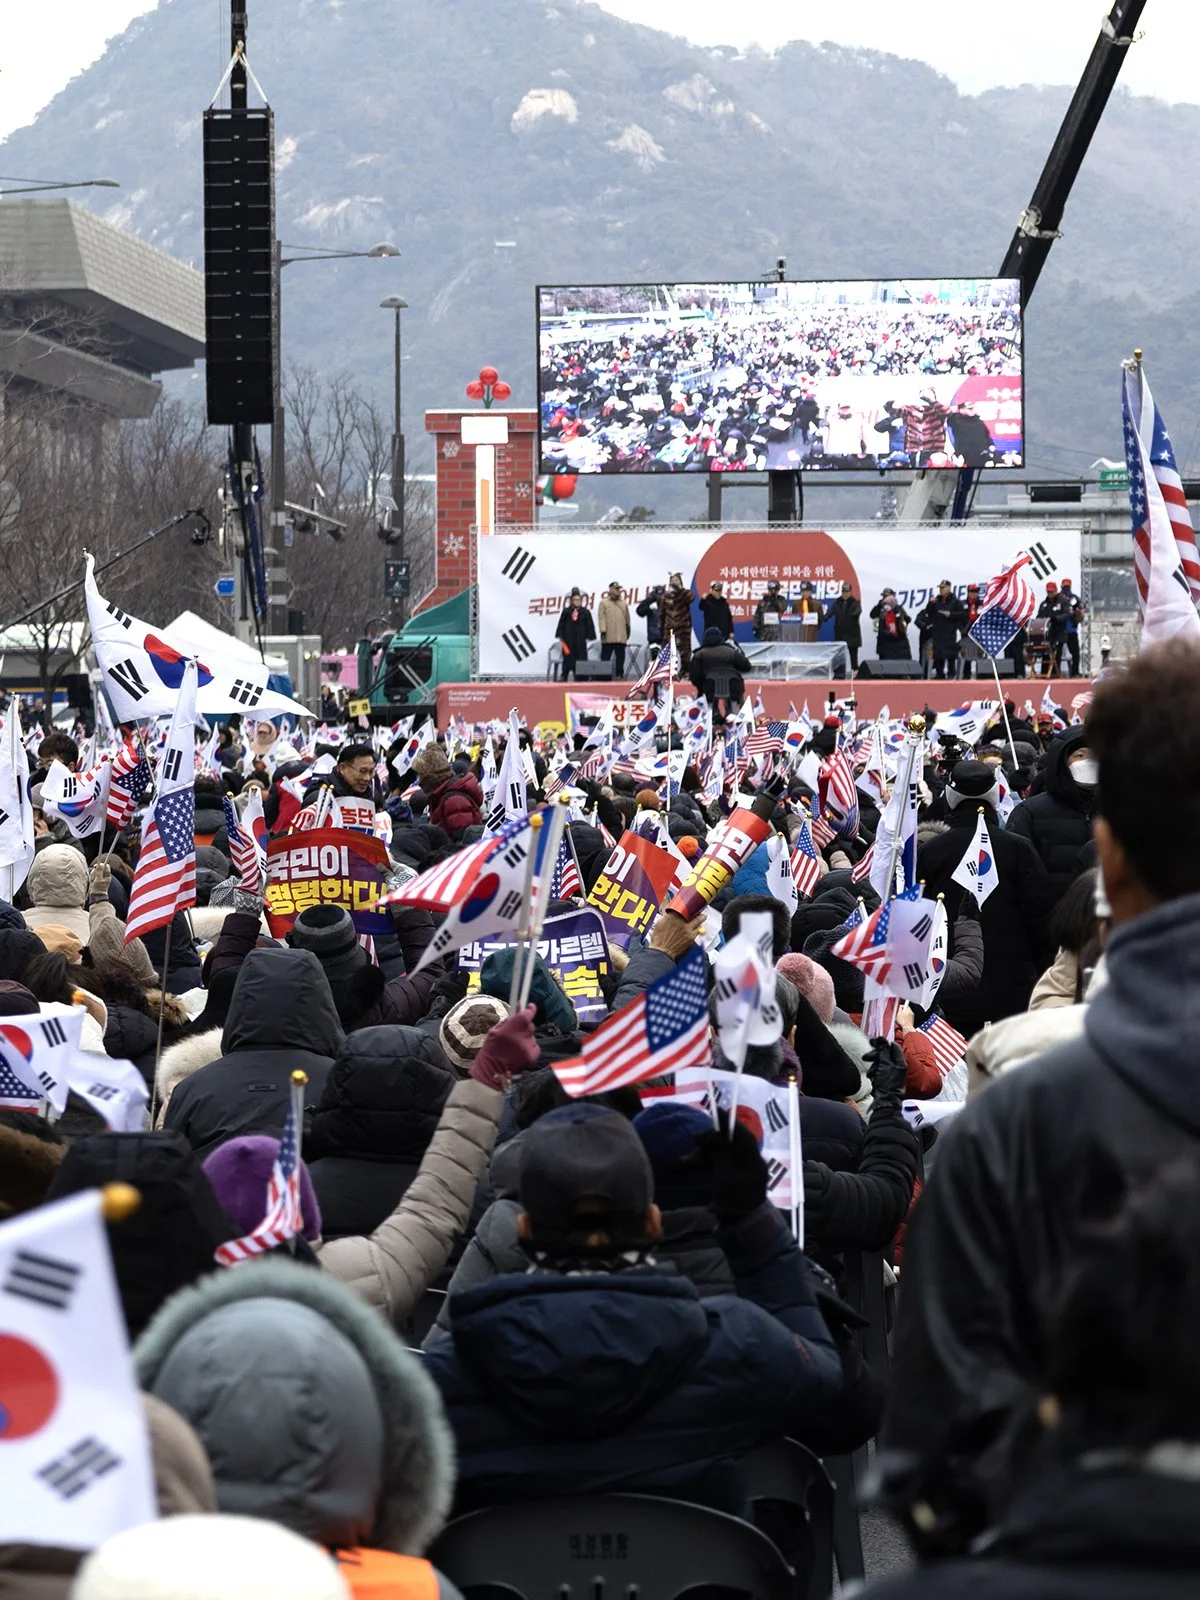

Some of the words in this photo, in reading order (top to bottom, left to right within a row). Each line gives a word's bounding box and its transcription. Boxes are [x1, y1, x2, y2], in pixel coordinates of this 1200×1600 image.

[815, 566, 835, 577] 위한
[612, 704, 646, 722] 상주
[267, 845, 349, 881] 국민이
[266, 878, 388, 917] 명령한다!
